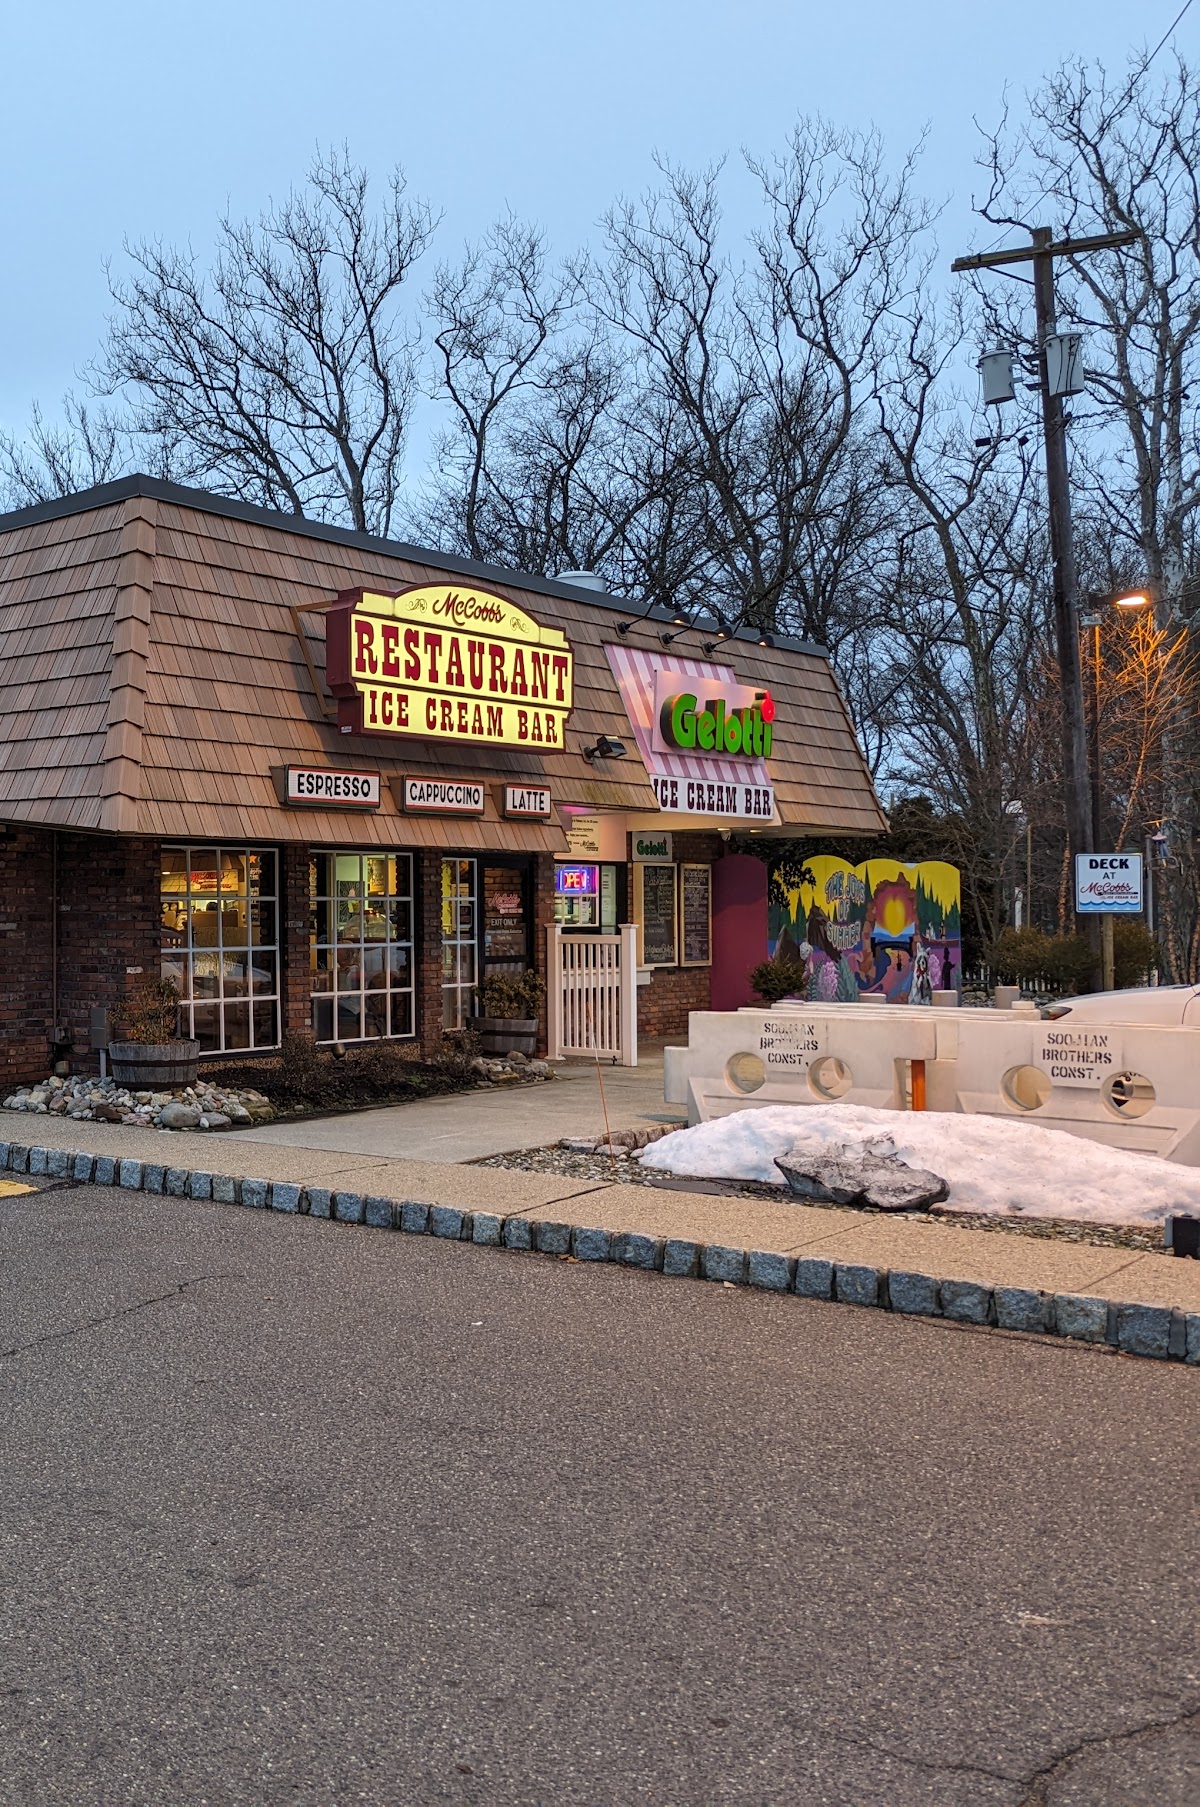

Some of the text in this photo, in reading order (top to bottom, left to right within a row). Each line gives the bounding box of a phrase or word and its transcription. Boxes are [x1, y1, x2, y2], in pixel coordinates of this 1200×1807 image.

[432, 592, 506, 626] McCobb's
[355, 619, 568, 701] RESTAURANT
[369, 690, 558, 743] ICE CREAM BAR
[660, 690, 776, 758] Gelotti
[297, 773, 370, 797] ESPRESSO
[410, 782, 480, 805] CAPPUCCINO
[512, 789, 545, 811] LATTE
[687, 781, 737, 813] CREAM
[744, 787, 772, 816] BAR
[1089, 858, 1129, 869] DECK
[825, 869, 844, 904] THE
[1102, 871, 1116, 880] AT
[1080, 881, 1133, 896] McCobb's
[491, 918, 517, 926] EXIT ONLY
[826, 921, 861, 951] SUMMER
[760, 1037, 818, 1051] BRERS
[1042, 1048, 1112, 1064] BROTHERS
[1051, 1065, 1100, 1080] CONST.
